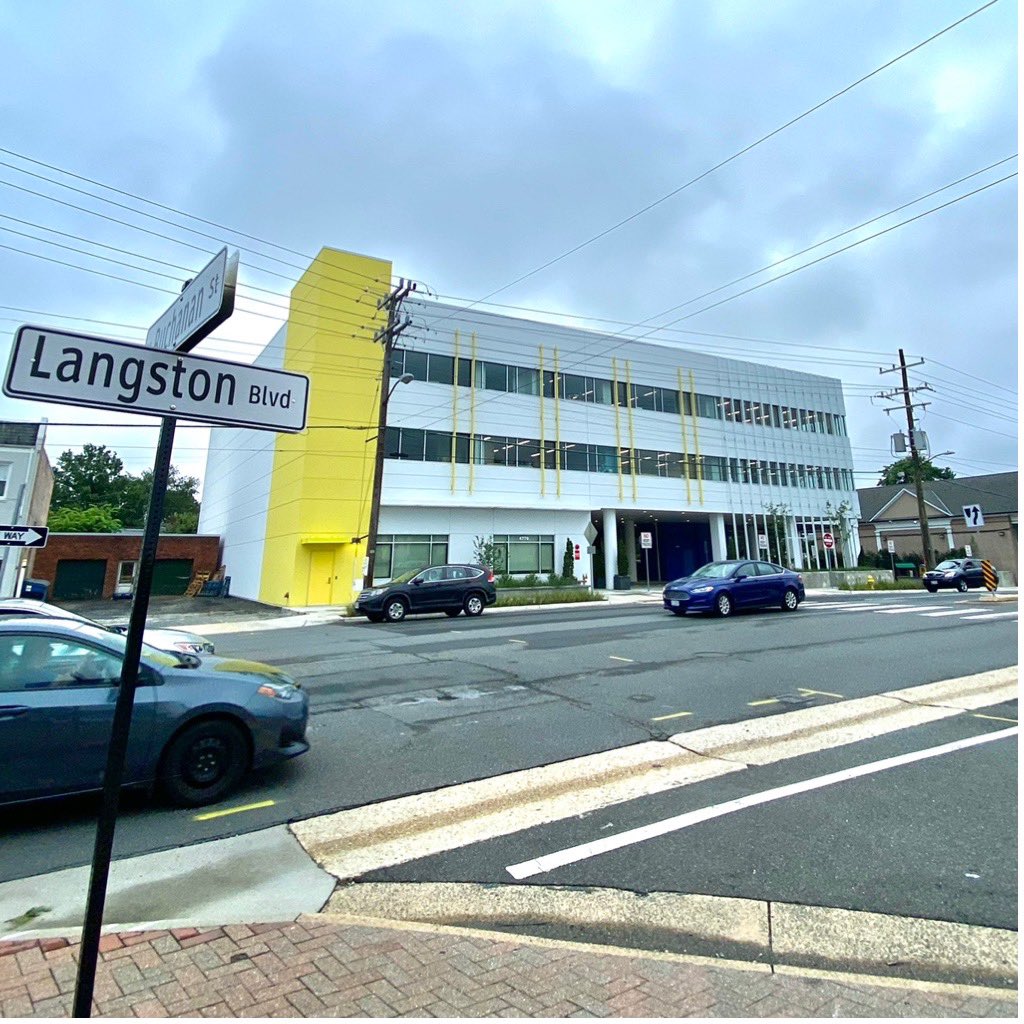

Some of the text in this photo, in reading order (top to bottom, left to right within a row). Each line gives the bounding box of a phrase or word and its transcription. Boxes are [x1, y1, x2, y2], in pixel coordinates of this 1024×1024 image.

[29, 335, 292, 409] Langston Blvd
[4, 532, 25, 540] WAY
